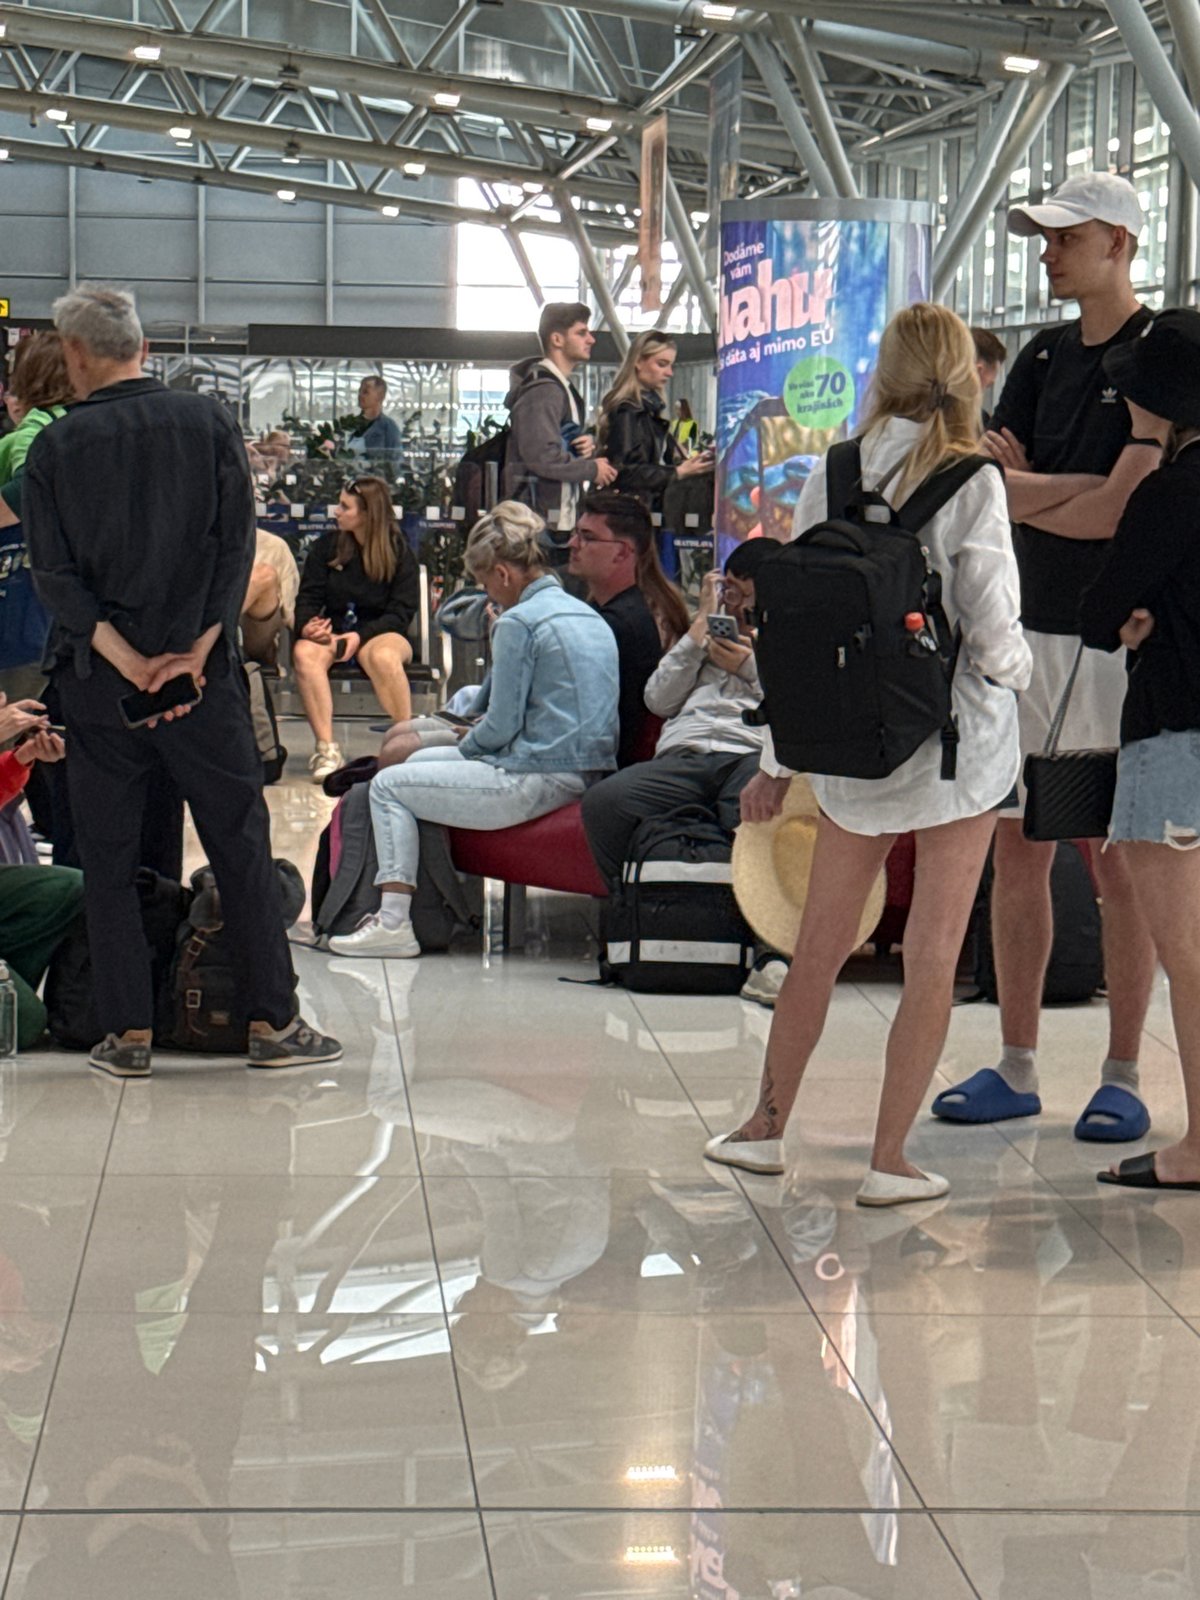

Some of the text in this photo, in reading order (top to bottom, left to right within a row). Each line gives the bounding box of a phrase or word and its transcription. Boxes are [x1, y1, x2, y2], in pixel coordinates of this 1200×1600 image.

[723, 242, 765, 266] Dodáme
[730, 263, 752, 280] vám
[725, 348, 747, 367] dáta
[749, 341, 761, 363] aj
[764, 336, 806, 356] mimo
[815, 371, 846, 398] 70
